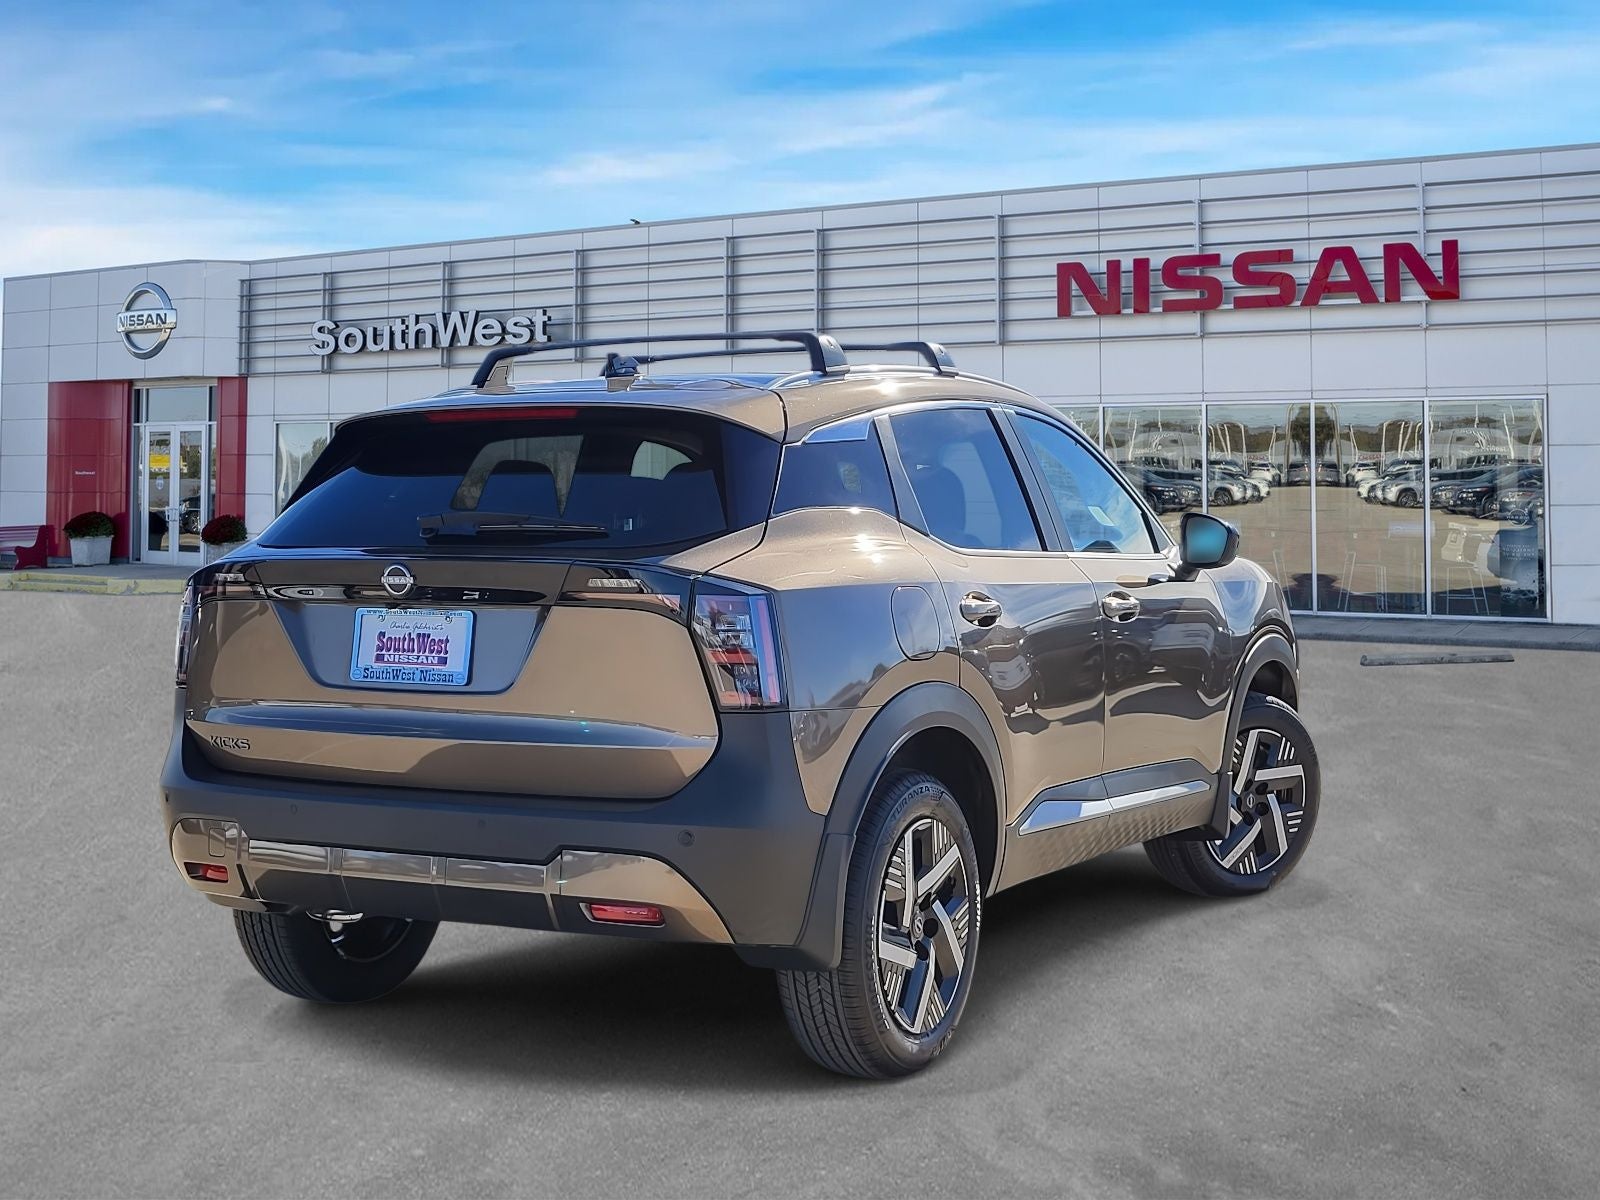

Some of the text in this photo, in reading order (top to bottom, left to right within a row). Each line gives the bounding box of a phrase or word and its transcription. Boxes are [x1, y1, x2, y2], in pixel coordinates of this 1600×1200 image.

[1057, 239, 1460, 318] NISSAN
[119, 312, 167, 328] NISSAN
[309, 309, 551, 356] SouthWest
[375, 631, 449, 655] SouthWest
[384, 655, 438, 664] NISSAN
[363, 667, 454, 682] SouthWest Nissan
[210, 735, 251, 750] KICKS
[890, 785, 930, 820] TURANZA
